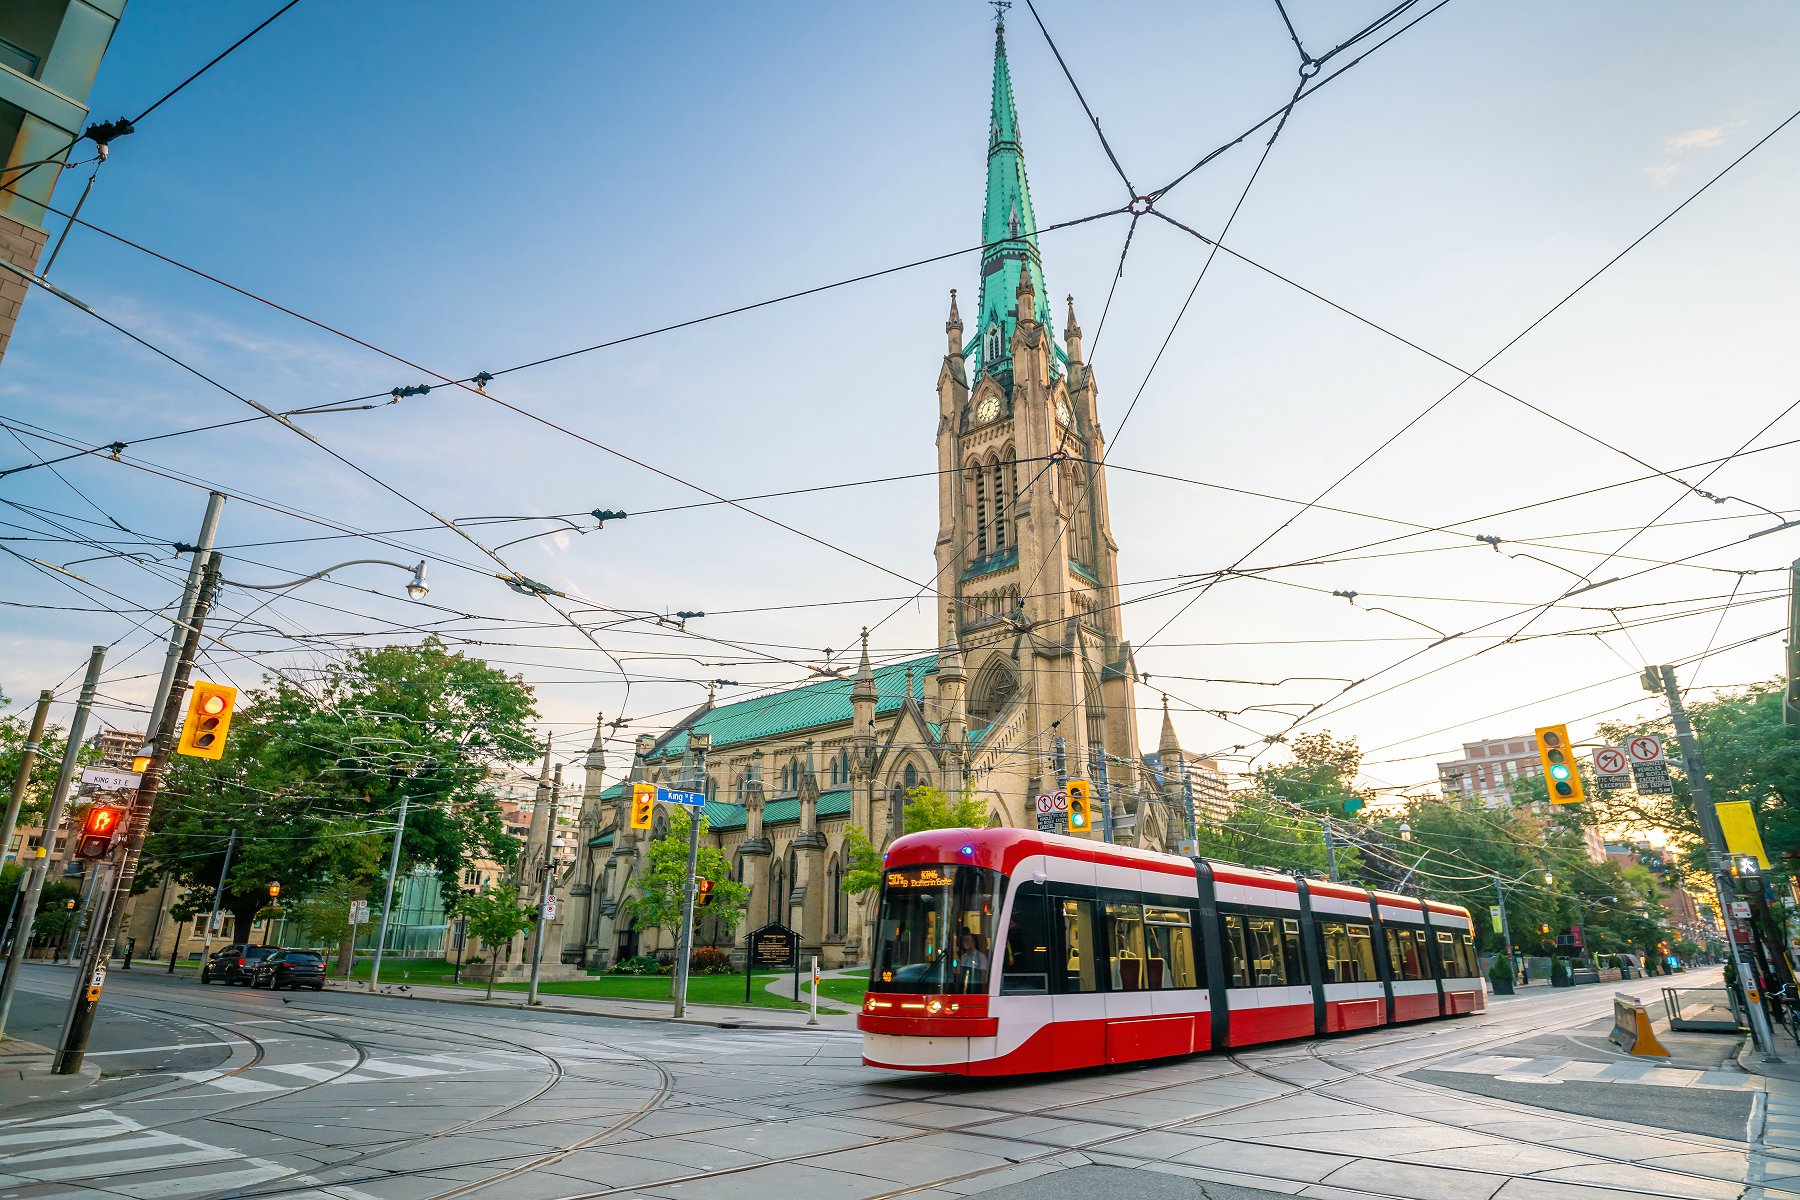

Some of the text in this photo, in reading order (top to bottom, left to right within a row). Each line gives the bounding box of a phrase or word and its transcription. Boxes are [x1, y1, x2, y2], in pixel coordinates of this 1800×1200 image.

[94, 776, 110, 784] KING
[668, 792, 683, 803] King
[689, 793, 695, 803] E
